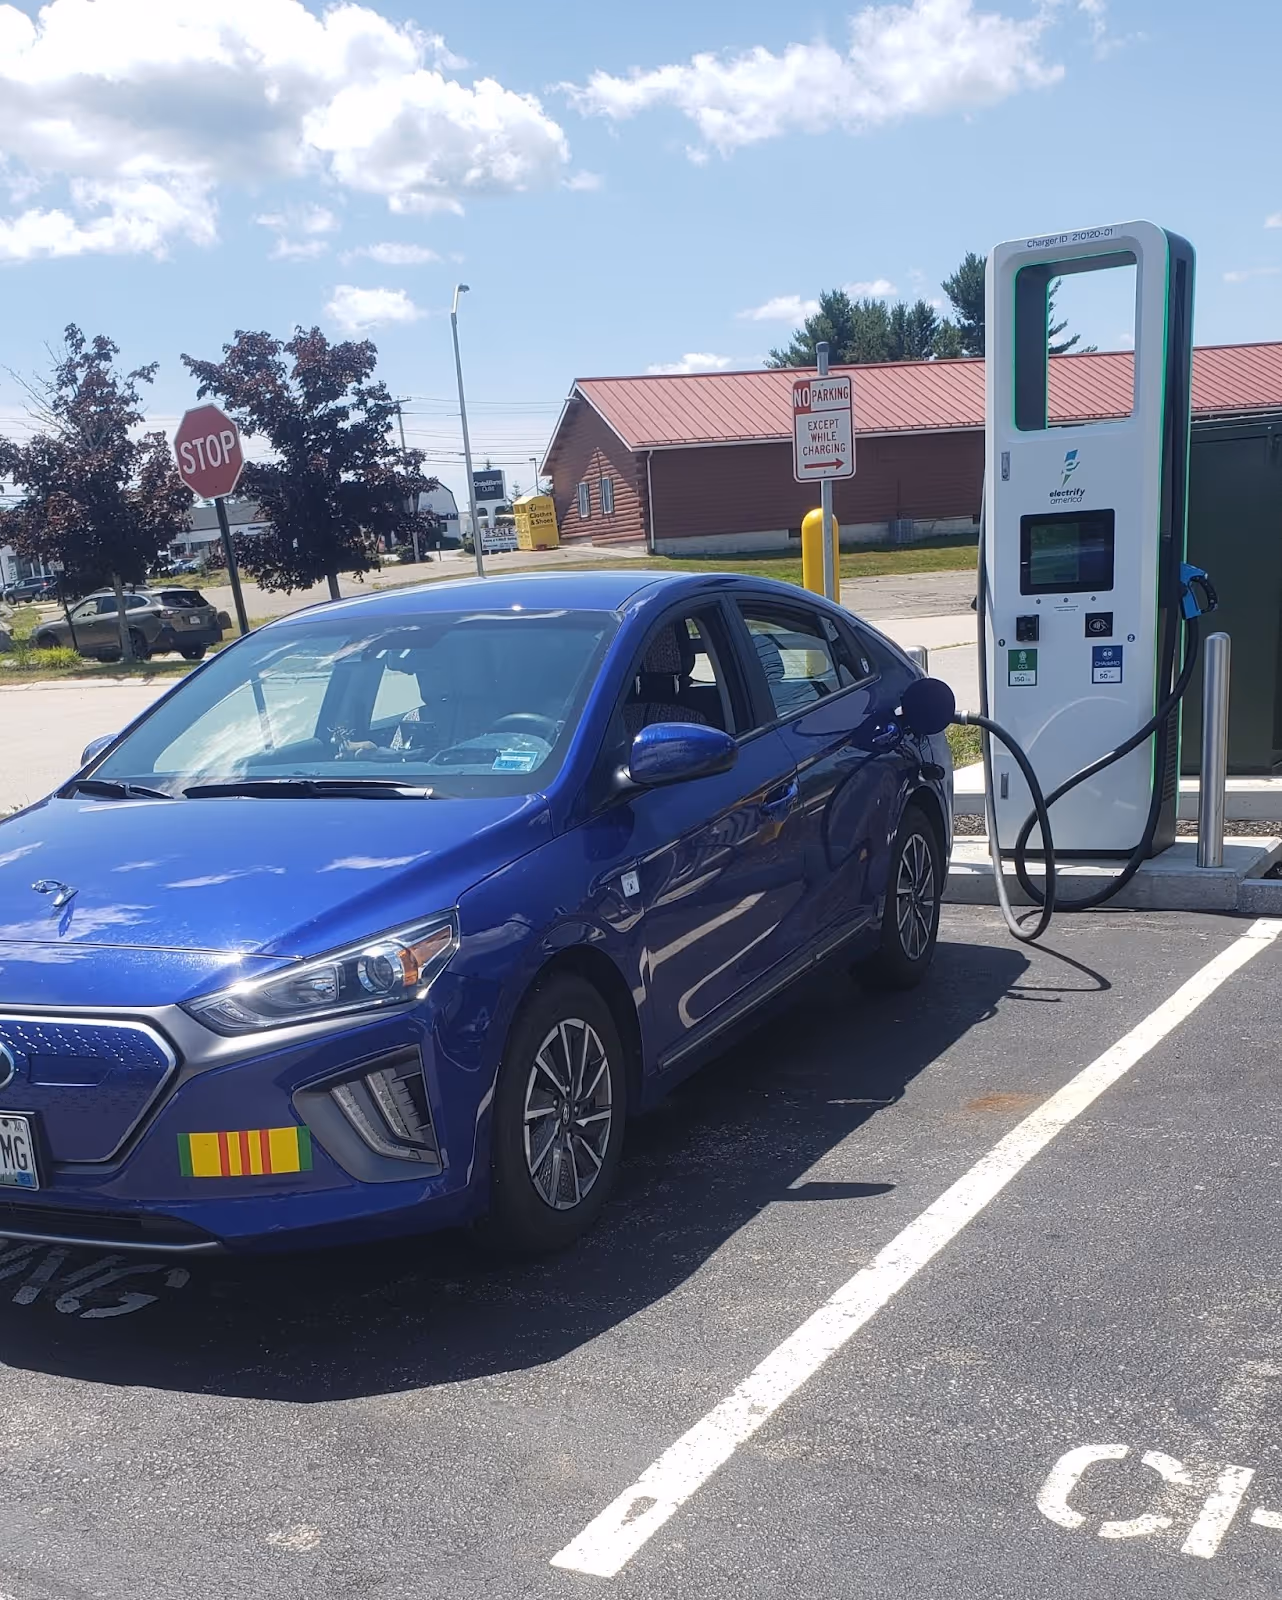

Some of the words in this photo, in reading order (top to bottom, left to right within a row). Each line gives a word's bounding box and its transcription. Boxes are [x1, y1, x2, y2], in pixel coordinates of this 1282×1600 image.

[1027, 237, 1058, 248] Charger
[1059, 235, 1068, 243] ID
[1072, 228, 1113, 241] 210120-01
[793, 387, 811, 408] NO
[812, 386, 849, 403] PARKING
[807, 419, 840, 431] EXCEPT
[810, 431, 837, 443] WHILE
[180, 430, 235, 474] STOP
[802, 443, 846, 456] CHARGING
[1049, 488, 1085, 497] electrify
[1050, 496, 1083, 504] america
[0, 1133, 28, 1170] MG
